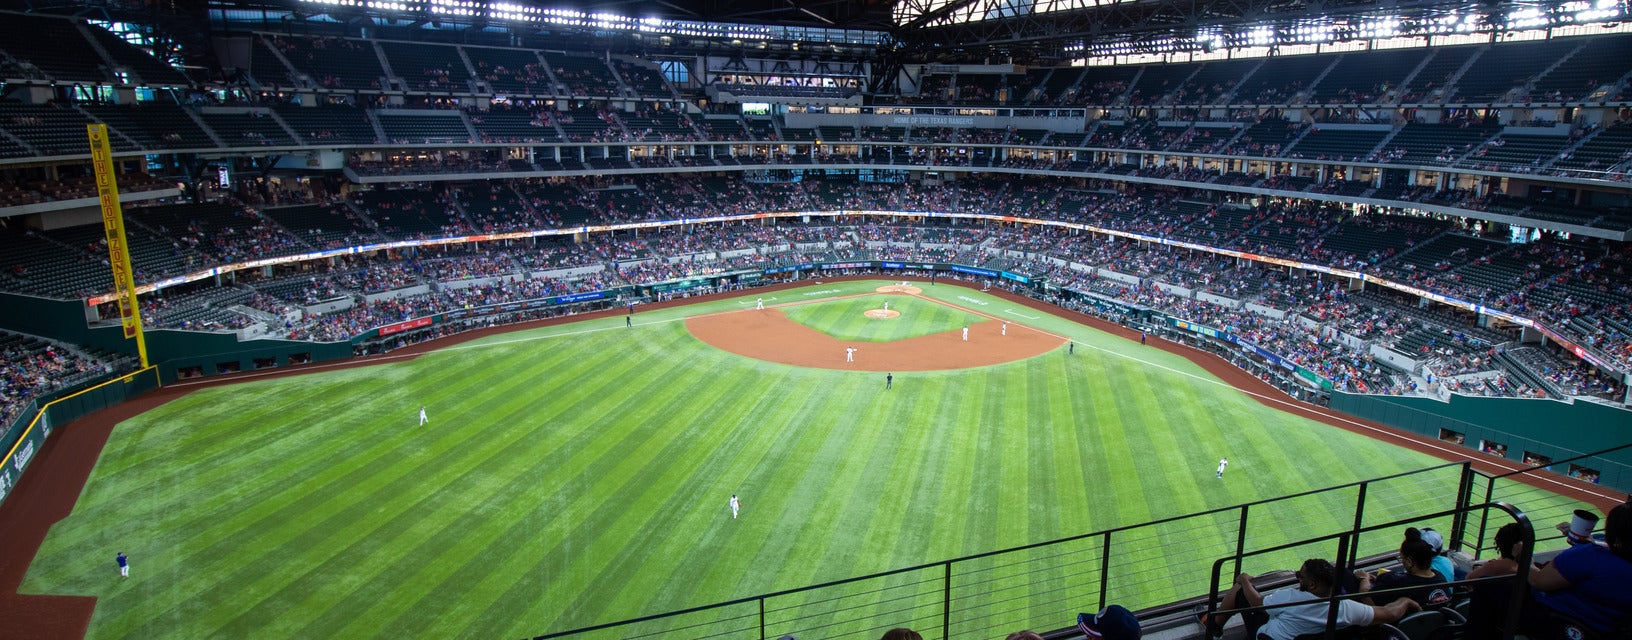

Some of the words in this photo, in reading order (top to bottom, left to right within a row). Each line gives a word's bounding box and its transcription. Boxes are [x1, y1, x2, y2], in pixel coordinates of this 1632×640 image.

[930, 117, 947, 125] TEXAS
[948, 117, 974, 125] RANGERS
[95, 150, 106, 185] THE
[103, 194, 114, 228] HOT
[111, 239, 124, 284] ZONE
